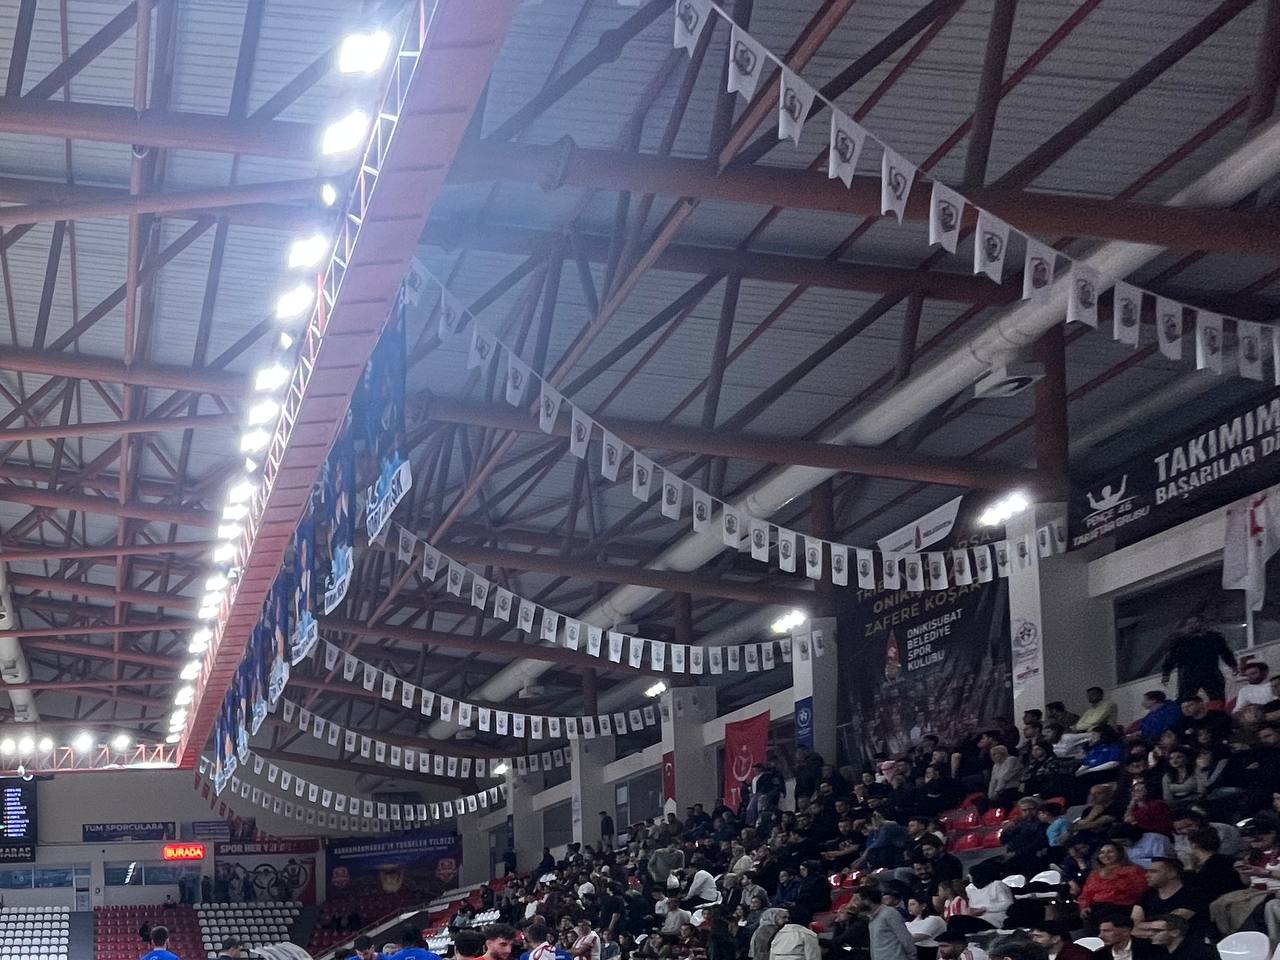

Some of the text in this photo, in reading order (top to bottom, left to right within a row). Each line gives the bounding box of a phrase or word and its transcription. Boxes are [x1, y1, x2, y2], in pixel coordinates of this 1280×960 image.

[864, 602, 920, 638] ZAFERE
[907, 644, 932, 660] SPOR
[166, 847, 202, 858] BURADA
